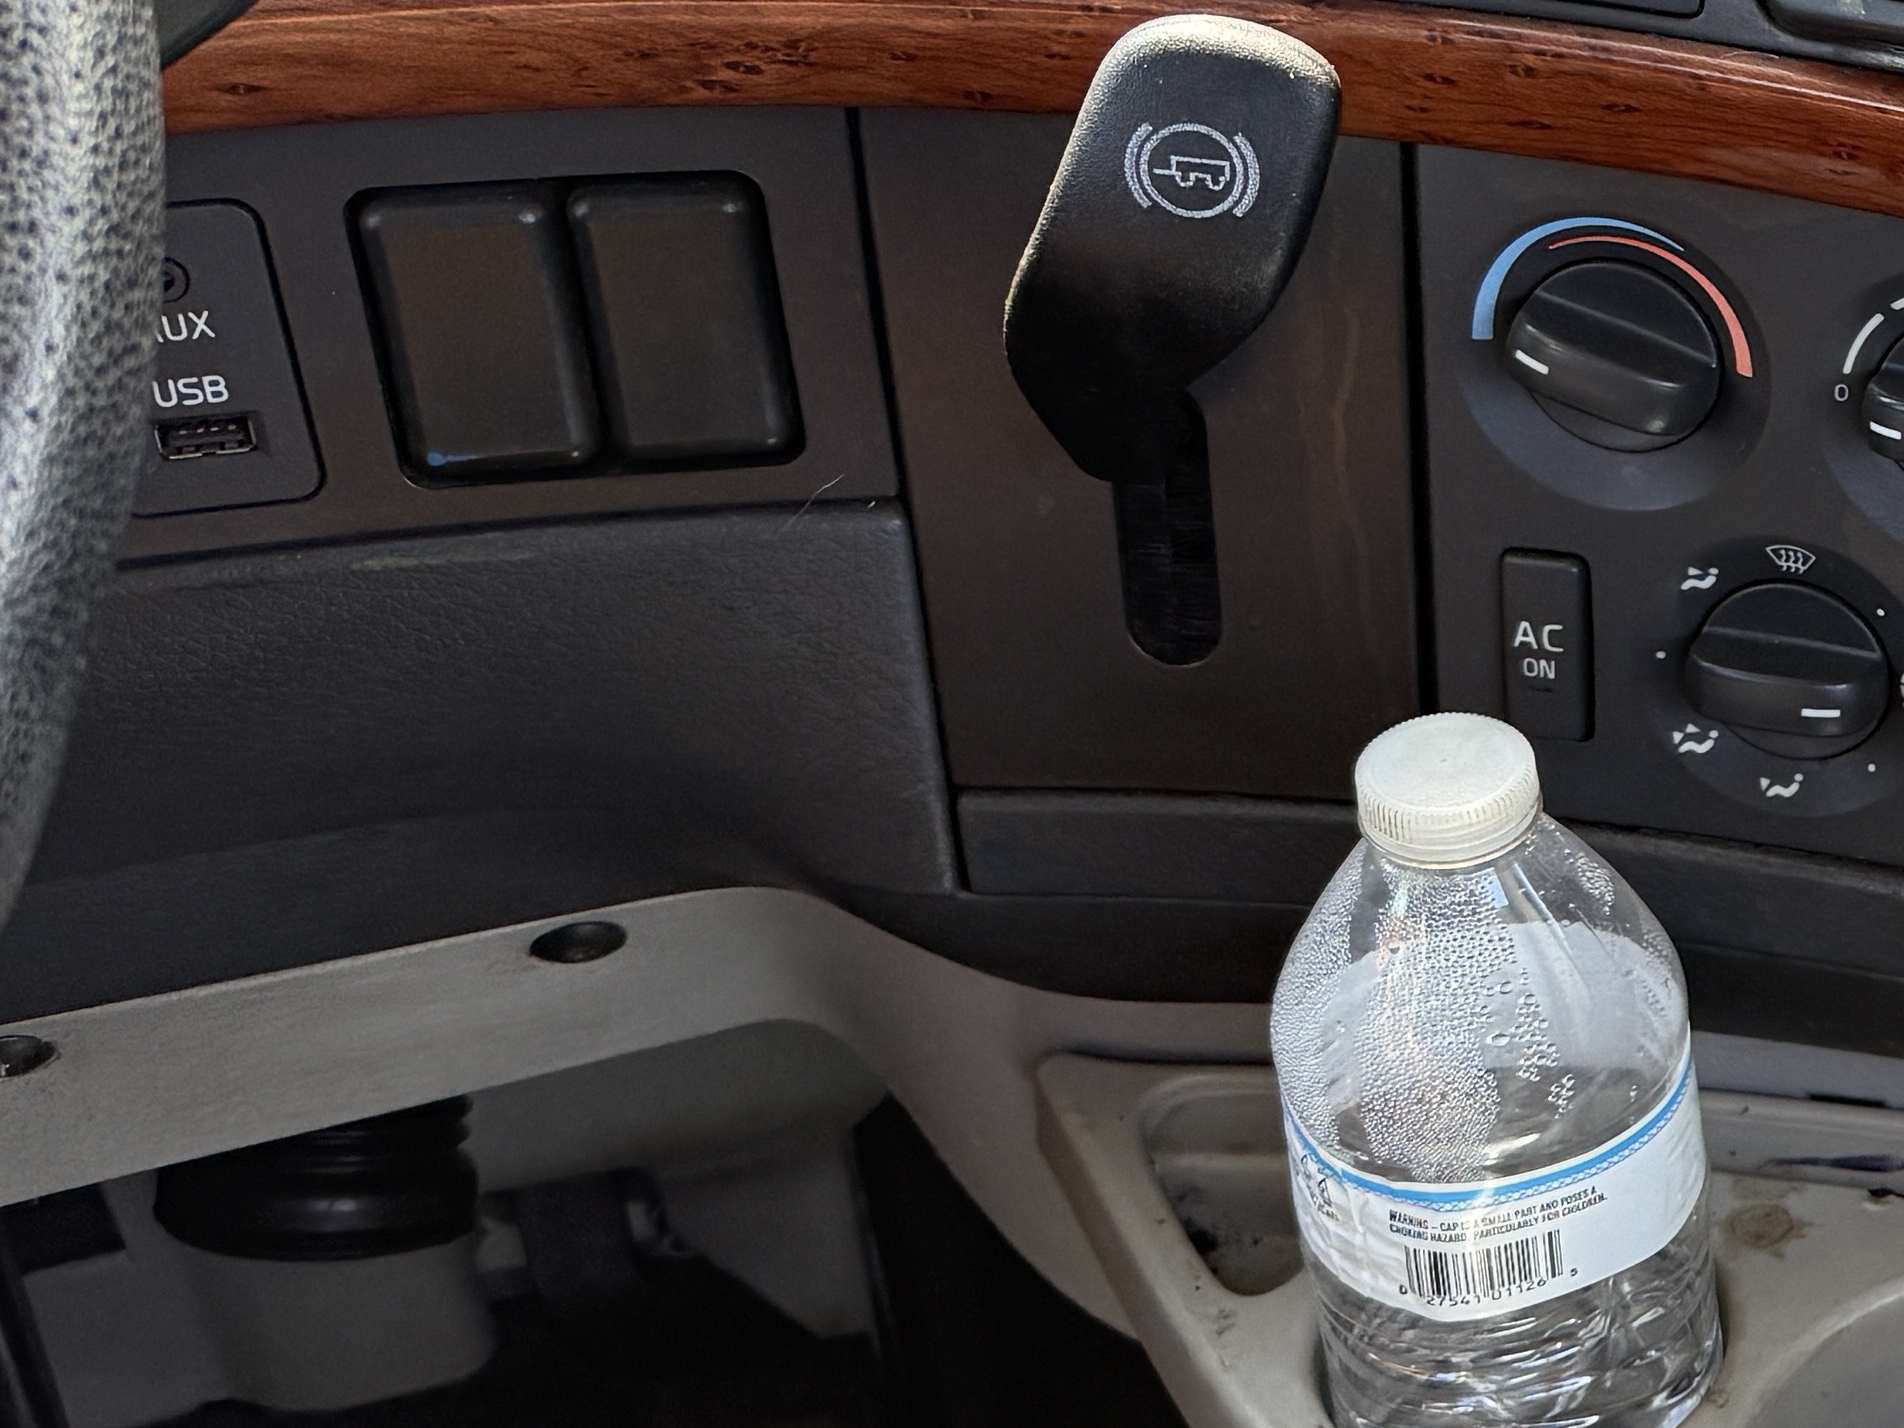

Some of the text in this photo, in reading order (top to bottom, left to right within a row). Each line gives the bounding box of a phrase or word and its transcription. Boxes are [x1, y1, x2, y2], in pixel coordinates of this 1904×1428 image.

[156, 309, 216, 342] UX
[151, 374, 230, 408] USB
[1523, 657, 1556, 679] ON
[1389, 1209, 1429, 1230] WARNING
[1440, 1221, 1459, 1232] CAP
[1481, 1211, 1512, 1227] SMALL
[1514, 1204, 1537, 1220] PART
[1540, 1198, 1559, 1213] AND
[1560, 1188, 1589, 1207] POSES
[1590, 1185, 1598, 1196] A
[1389, 1223, 1429, 1241] CHOKING
[1473, 1217, 1539, 1240] PARTICULARLY
[1541, 1210, 1561, 1223] FOR
